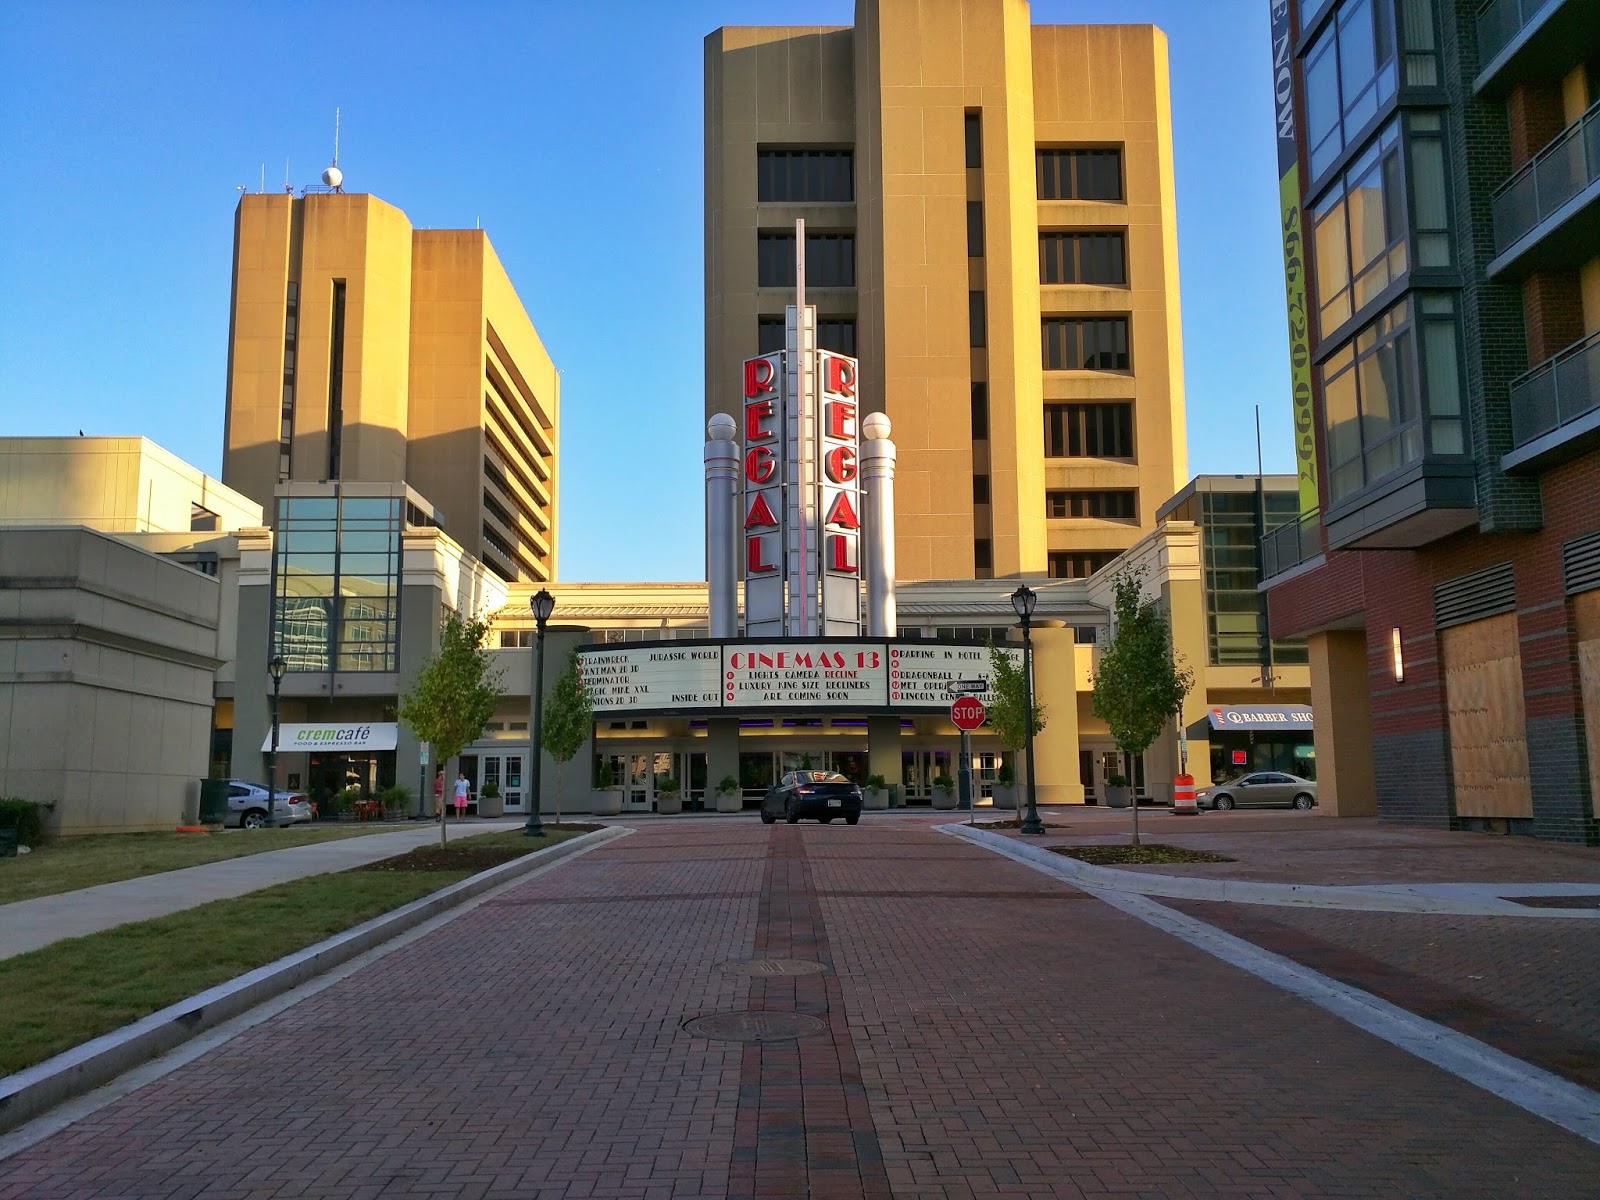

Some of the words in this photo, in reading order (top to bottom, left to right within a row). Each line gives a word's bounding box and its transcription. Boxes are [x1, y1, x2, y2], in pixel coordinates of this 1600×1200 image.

[1274, 28, 1294, 141] NOW
[744, 358, 778, 573] REGAL
[825, 356, 860, 574] REGAL
[649, 652, 686, 661] JURASSIC
[691, 651, 719, 660] WORLD
[900, 650, 935, 658] PARKING
[944, 651, 952, 659] IN
[958, 652, 981, 660] HOTEL
[730, 652, 846, 670] CINEMAS
[855, 651, 880, 669] 13
[749, 671, 779, 679] LIGHTS
[785, 671, 820, 679] CAMERA
[824, 670, 858, 679] RECLINE
[900, 671, 952, 680] DRAGONBALL
[584, 676, 630, 686] TERMINATOR
[739, 682, 772, 690] LUXURY
[778, 681, 798, 690] KING
[802, 681, 820, 689] SIZE
[826, 681, 870, 690] RECLINERS
[900, 682, 917, 690] MET
[612, 685, 630, 694] MIKE
[635, 685, 649, 693] XXL
[672, 693, 698, 702] INSIDE
[703, 693, 719, 701] OUT
[763, 692, 782, 701] ARE
[788, 692, 821, 700] COMING
[827, 692, 848, 700] SOON
[901, 692, 935, 701] LINCOLN
[954, 707, 983, 719] STOP
[1242, 712, 1288, 722] BARBER
